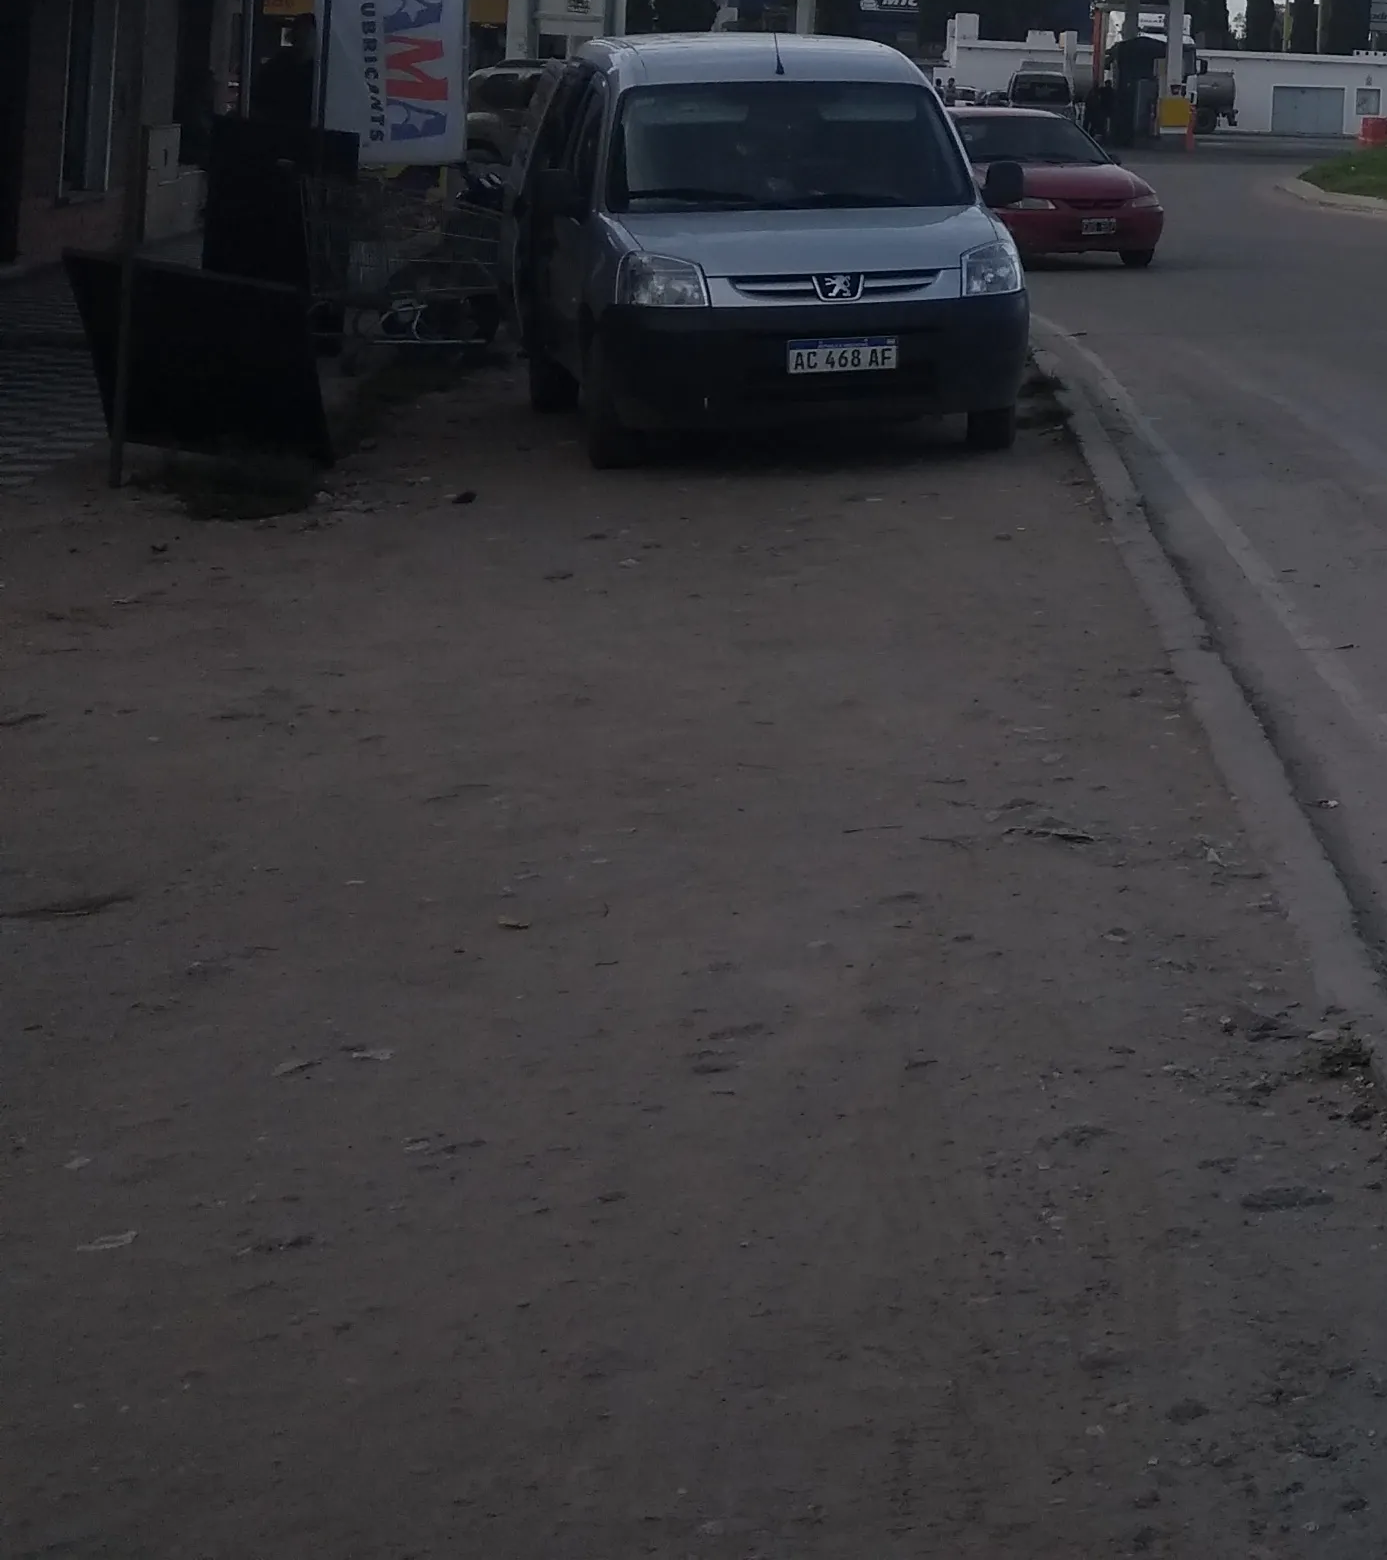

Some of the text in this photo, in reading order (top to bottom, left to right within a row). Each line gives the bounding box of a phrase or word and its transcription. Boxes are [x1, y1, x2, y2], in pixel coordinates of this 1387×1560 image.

[794, 347, 892, 370] AC 468 AF
